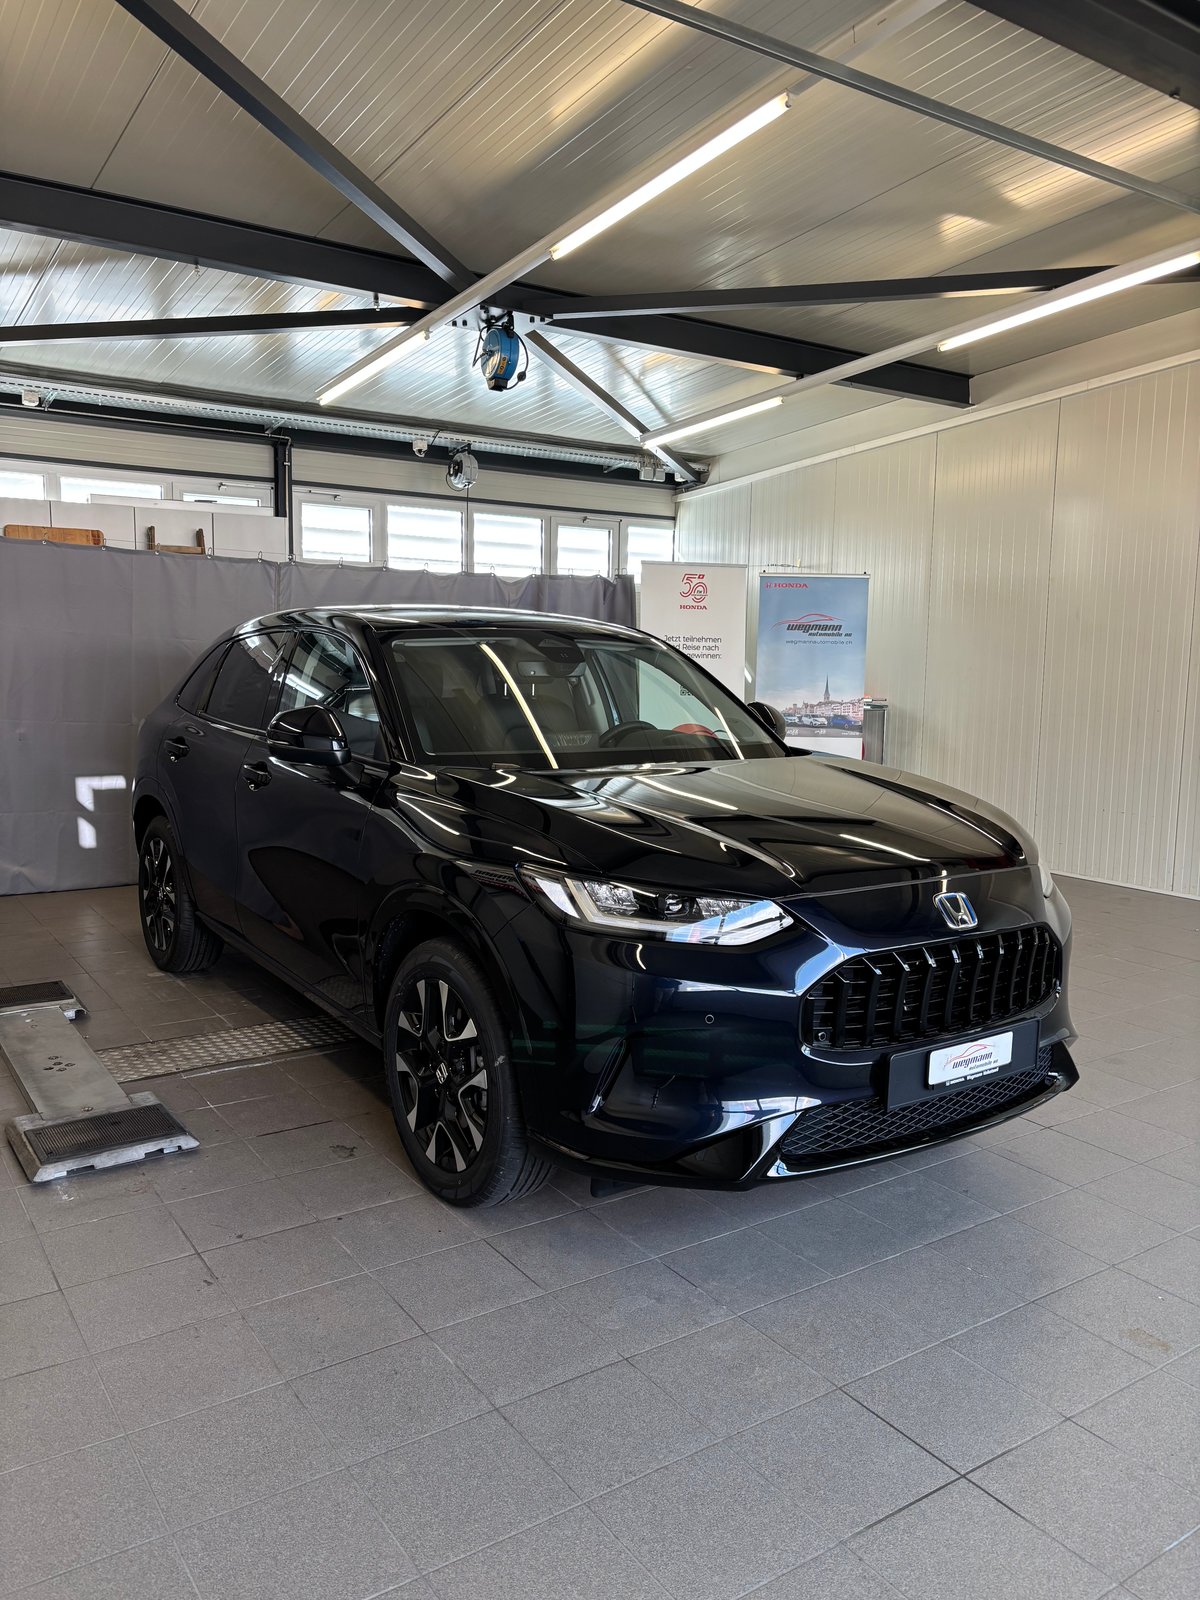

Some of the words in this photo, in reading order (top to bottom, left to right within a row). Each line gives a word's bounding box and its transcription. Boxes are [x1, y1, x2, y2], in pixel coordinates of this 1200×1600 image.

[786, 623, 843, 633] wegmann
[682, 635, 722, 643] teilnehmen
[682, 643, 701, 651] Reise
[952, 1052, 993, 1068] wegmann
